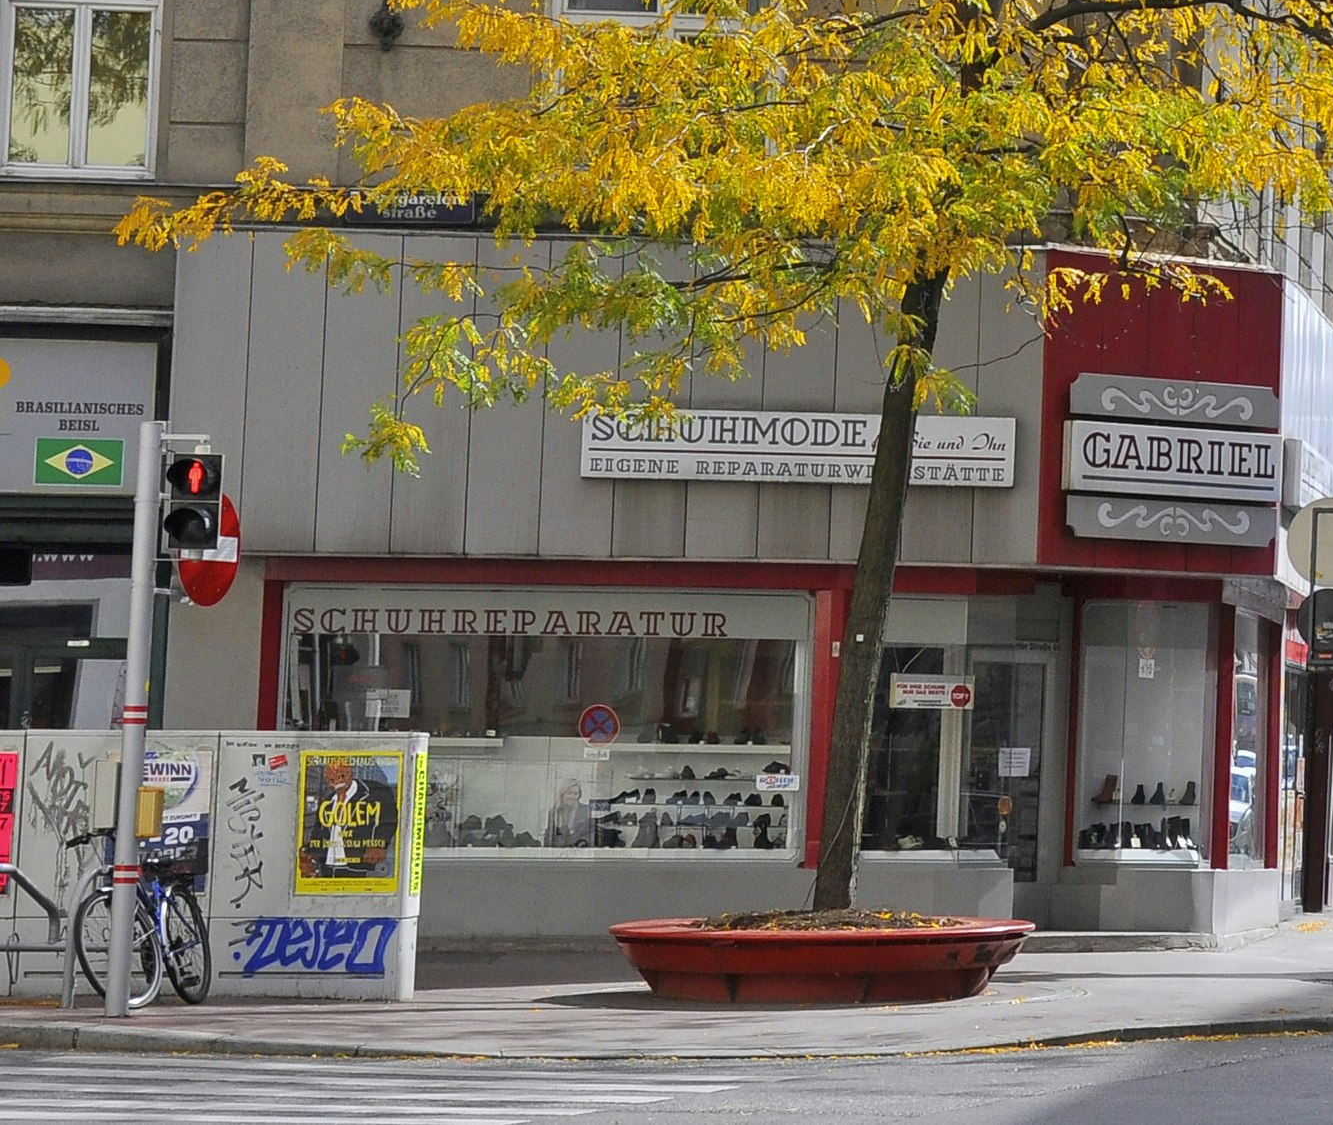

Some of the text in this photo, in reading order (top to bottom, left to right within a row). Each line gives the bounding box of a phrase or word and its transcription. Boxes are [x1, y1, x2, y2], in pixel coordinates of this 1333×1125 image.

[382, 207, 437, 219] straße
[16, 401, 144, 415] BRASILIANISCHES
[58, 419, 100, 431] BEISL
[591, 413, 867, 448] SCHUHMODE
[937, 434, 964, 450] und
[1083, 431, 1275, 479] GABRIEL
[589, 457, 1005, 482] EIGENE REPARATURWSTÄTTE
[294, 608, 728, 637] SCHUHREPARATUR
[141, 763, 192, 775] EWINN
[318, 799, 381, 828] GOLEM
